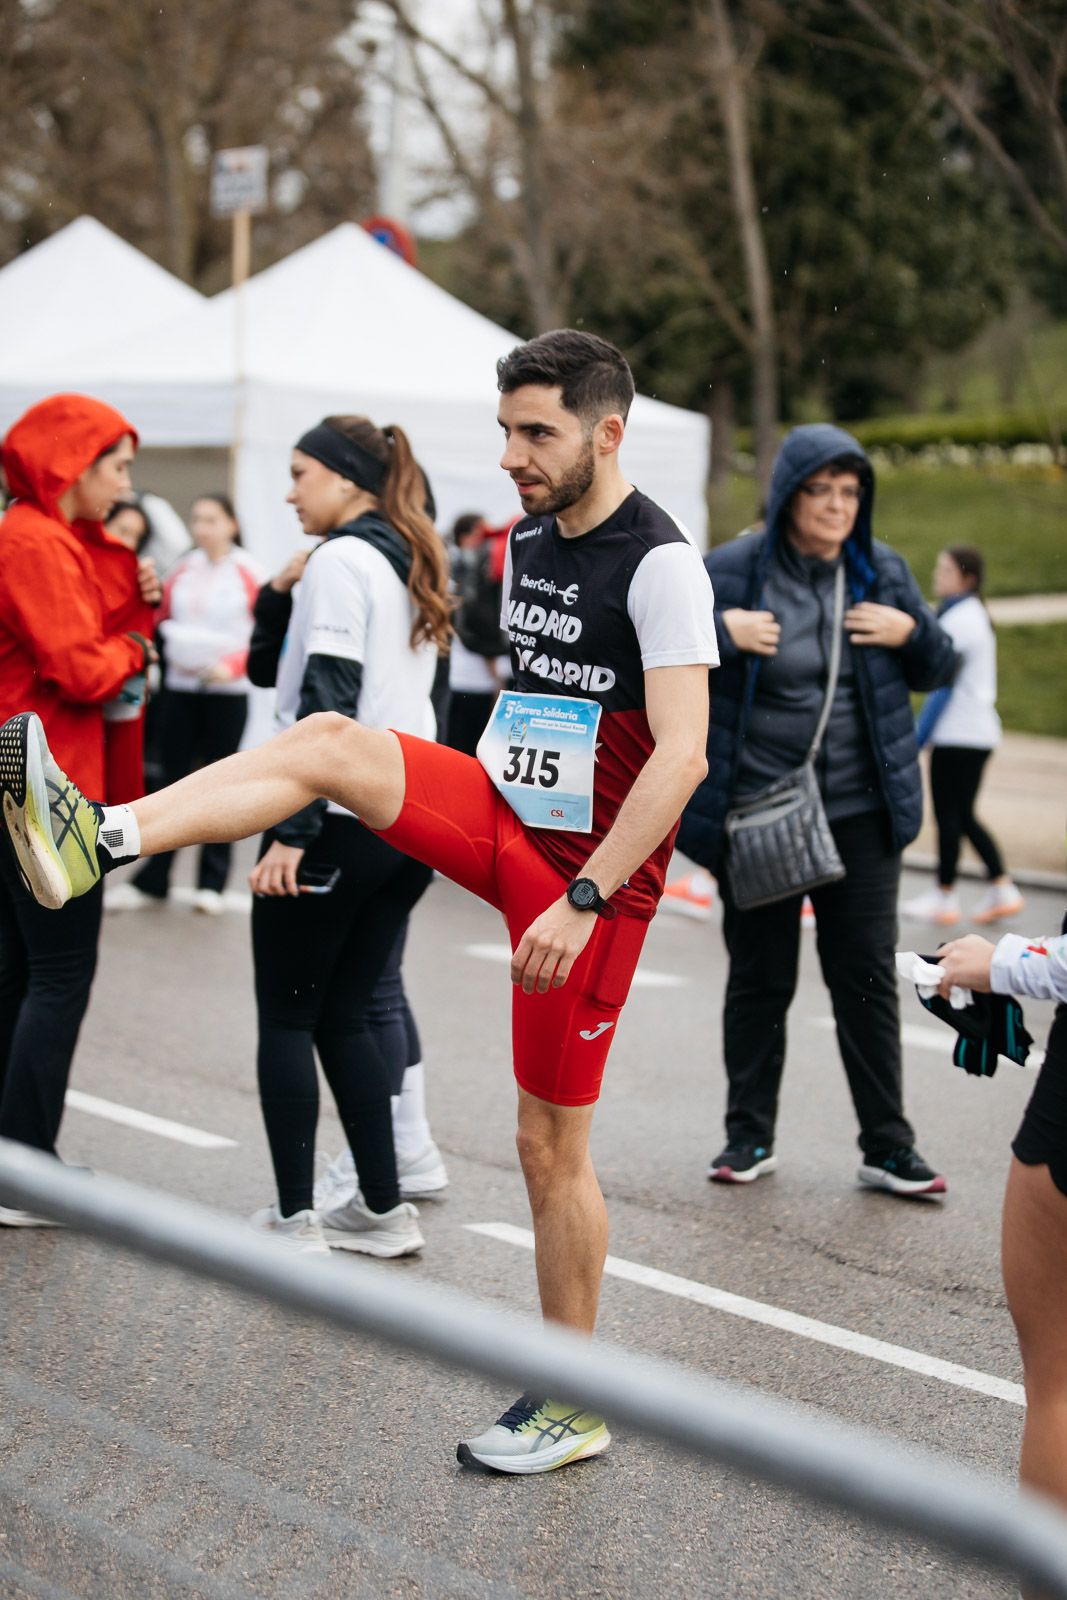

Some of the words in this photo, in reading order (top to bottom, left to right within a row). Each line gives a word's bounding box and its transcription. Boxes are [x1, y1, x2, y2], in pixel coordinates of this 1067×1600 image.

[515, 632, 537, 647] POR
[514, 704, 542, 717] Carrera
[542, 706, 579, 721] Solidaria
[503, 745, 561, 788] 315
[550, 809, 565, 818] CSL
